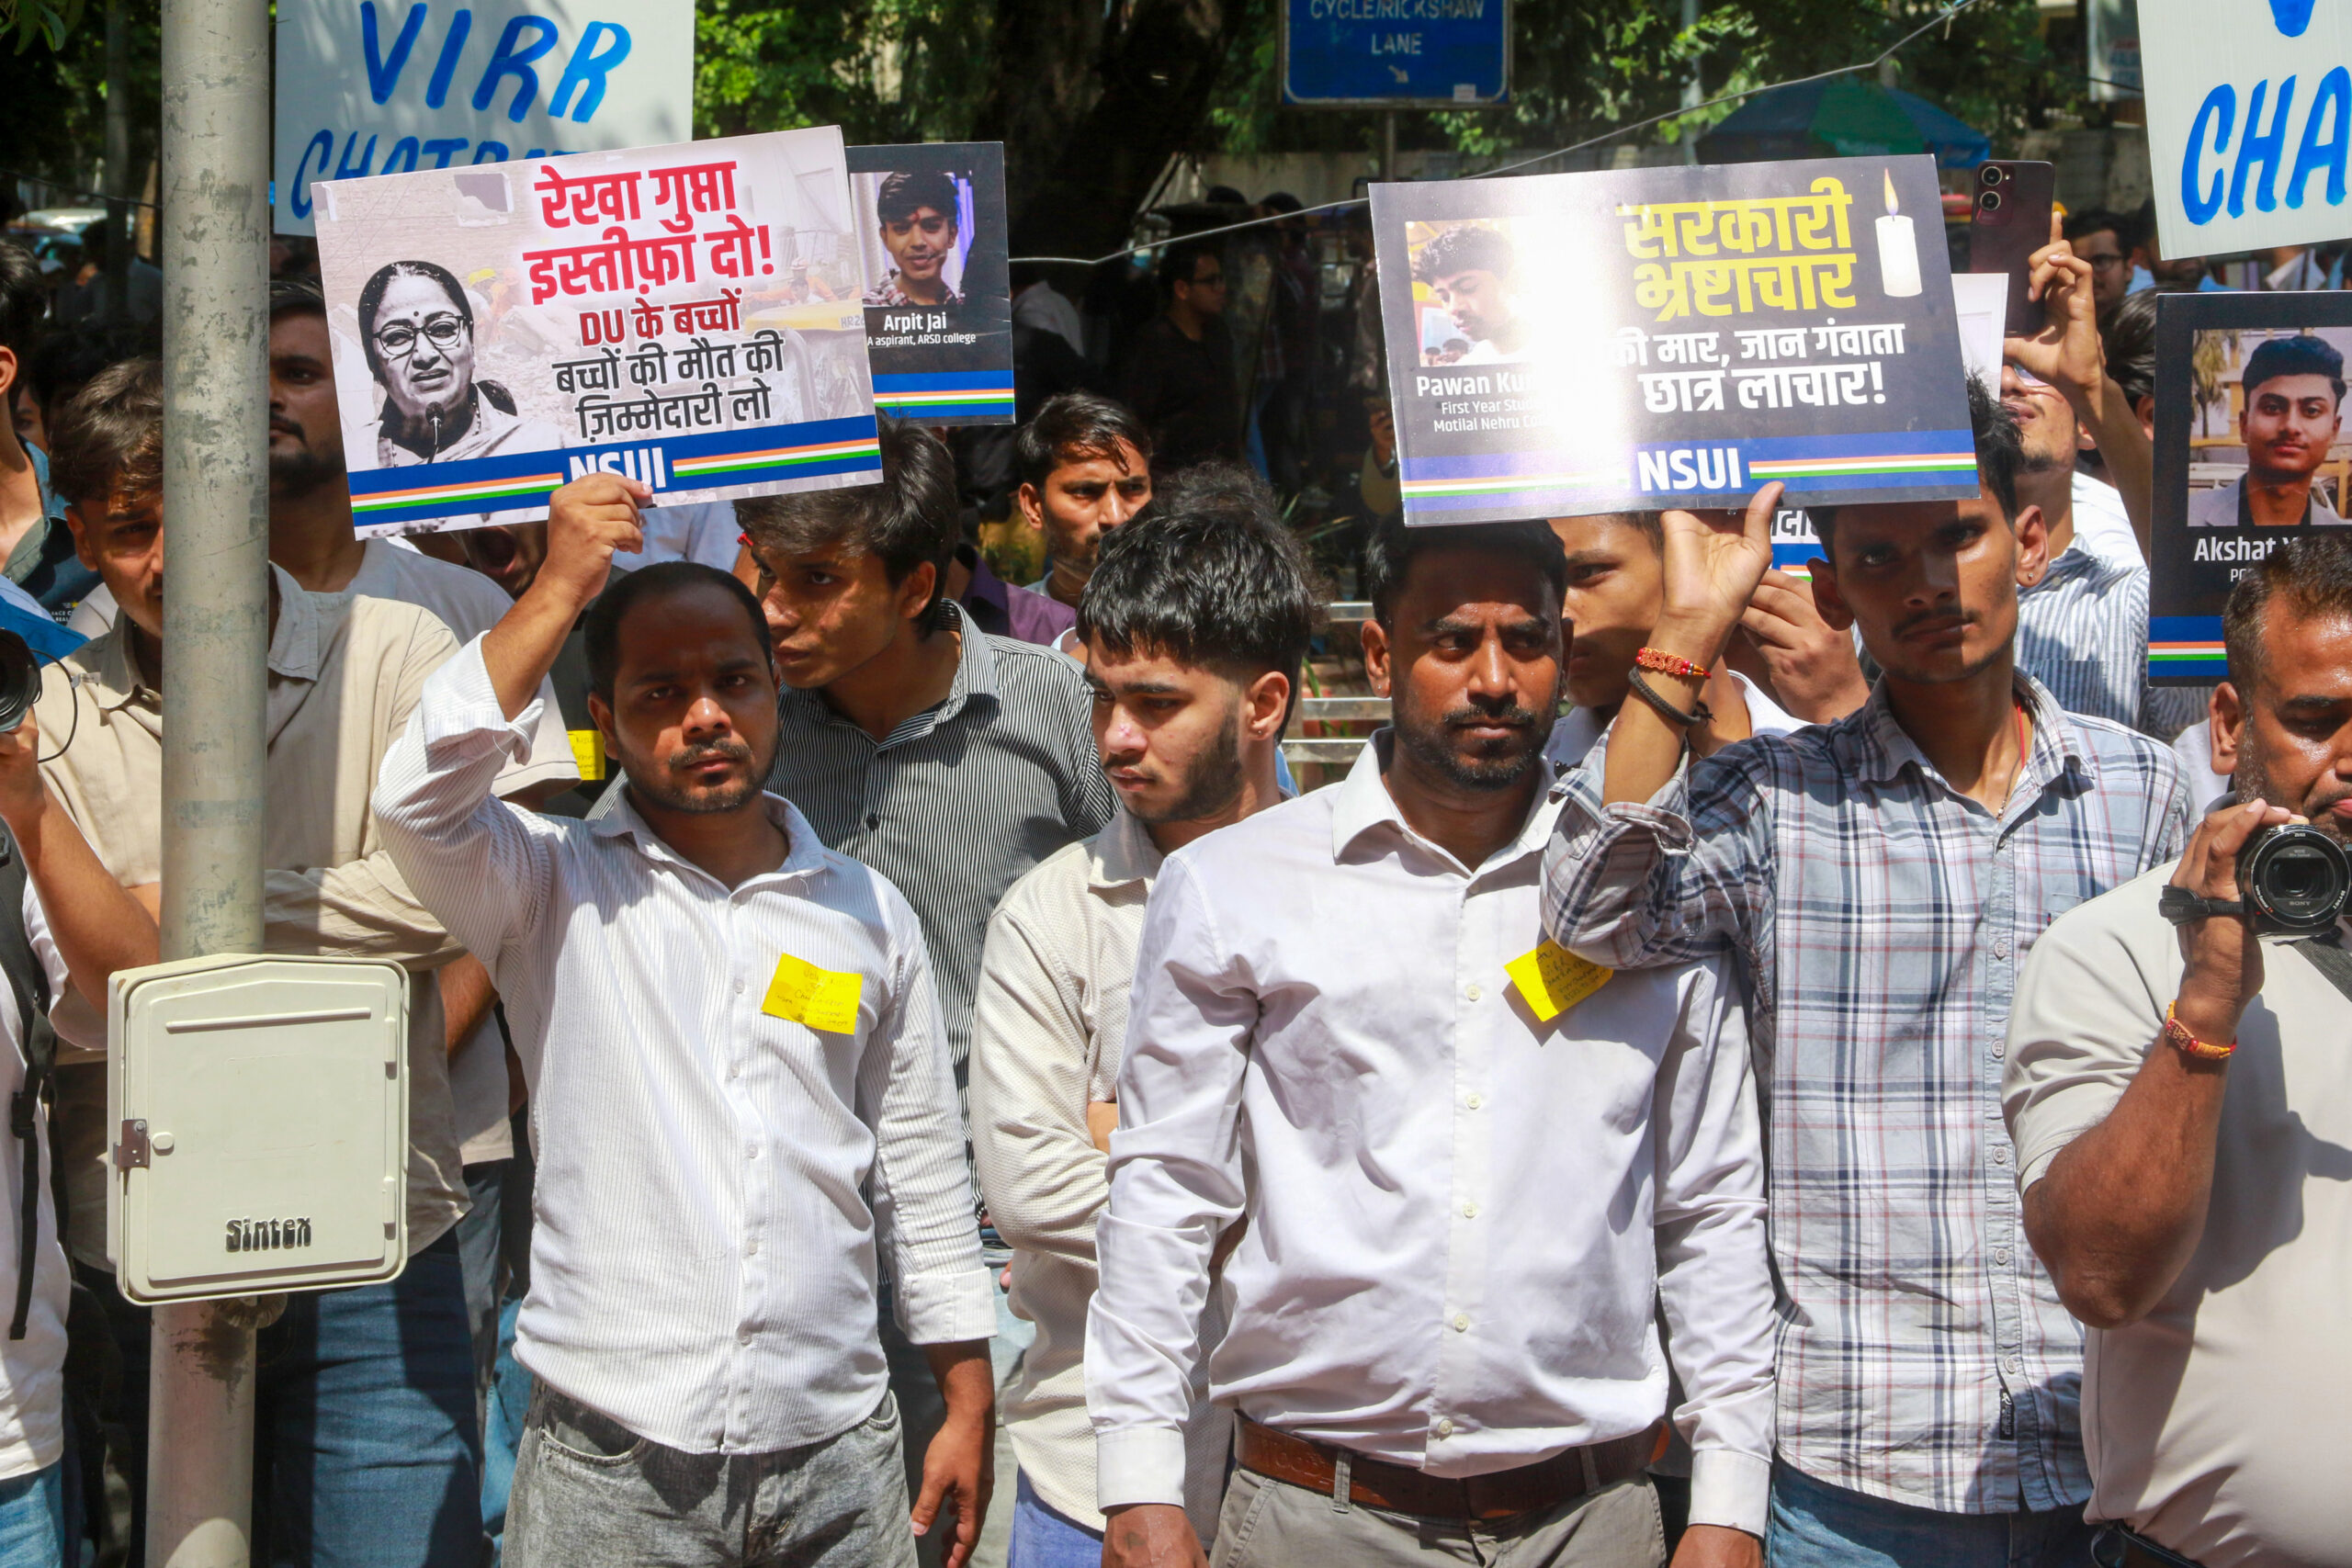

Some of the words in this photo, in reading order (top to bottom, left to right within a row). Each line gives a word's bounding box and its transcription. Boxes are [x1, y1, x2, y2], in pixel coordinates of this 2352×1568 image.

[360, 1, 632, 123] VIRR
[1371, 33, 1422, 54] LANE
[534, 165, 641, 228] रेखा
[649, 161, 737, 233] गुप्ता
[1615, 176, 1853, 259] सरकारी
[523, 226, 697, 305] इस्तीफ़ा
[704, 214, 775, 279] दो!
[1634, 253, 1858, 321] भ्रष्टाचार
[579, 309, 627, 346] DU
[631, 299, 663, 339] के
[670, 288, 741, 335] बच्चों
[875, 335, 916, 346] aspirant,
[918, 334, 941, 344] ARSD
[944, 333, 976, 344] college
[884, 313, 923, 333] Arpit
[927, 311, 946, 333] Jai
[1653, 332, 1730, 367] मार,
[1735, 328, 1808, 360] जान
[1811, 317, 1906, 357] गंवाता
[552, 347, 621, 393] बच्चों
[627, 343, 667, 385] की
[673, 338, 736, 380] मौत
[742, 330, 785, 372] की
[1416, 375, 1490, 397] Pawan
[575, 383, 723, 443] ज़िम्मेदारी
[728, 378, 772, 421] लो
[1442, 401, 1470, 414] First
[1472, 400, 1501, 413] Year
[1637, 369, 1727, 413] छात्र
[1731, 361, 1886, 410] लाचार!
[1433, 418, 1477, 432] Motilal
[1481, 417, 1521, 430] Nehru
[1637, 447, 1742, 492] NSUI
[2194, 536, 2277, 561] Akshat
[226, 1216, 311, 1253] Sintex
